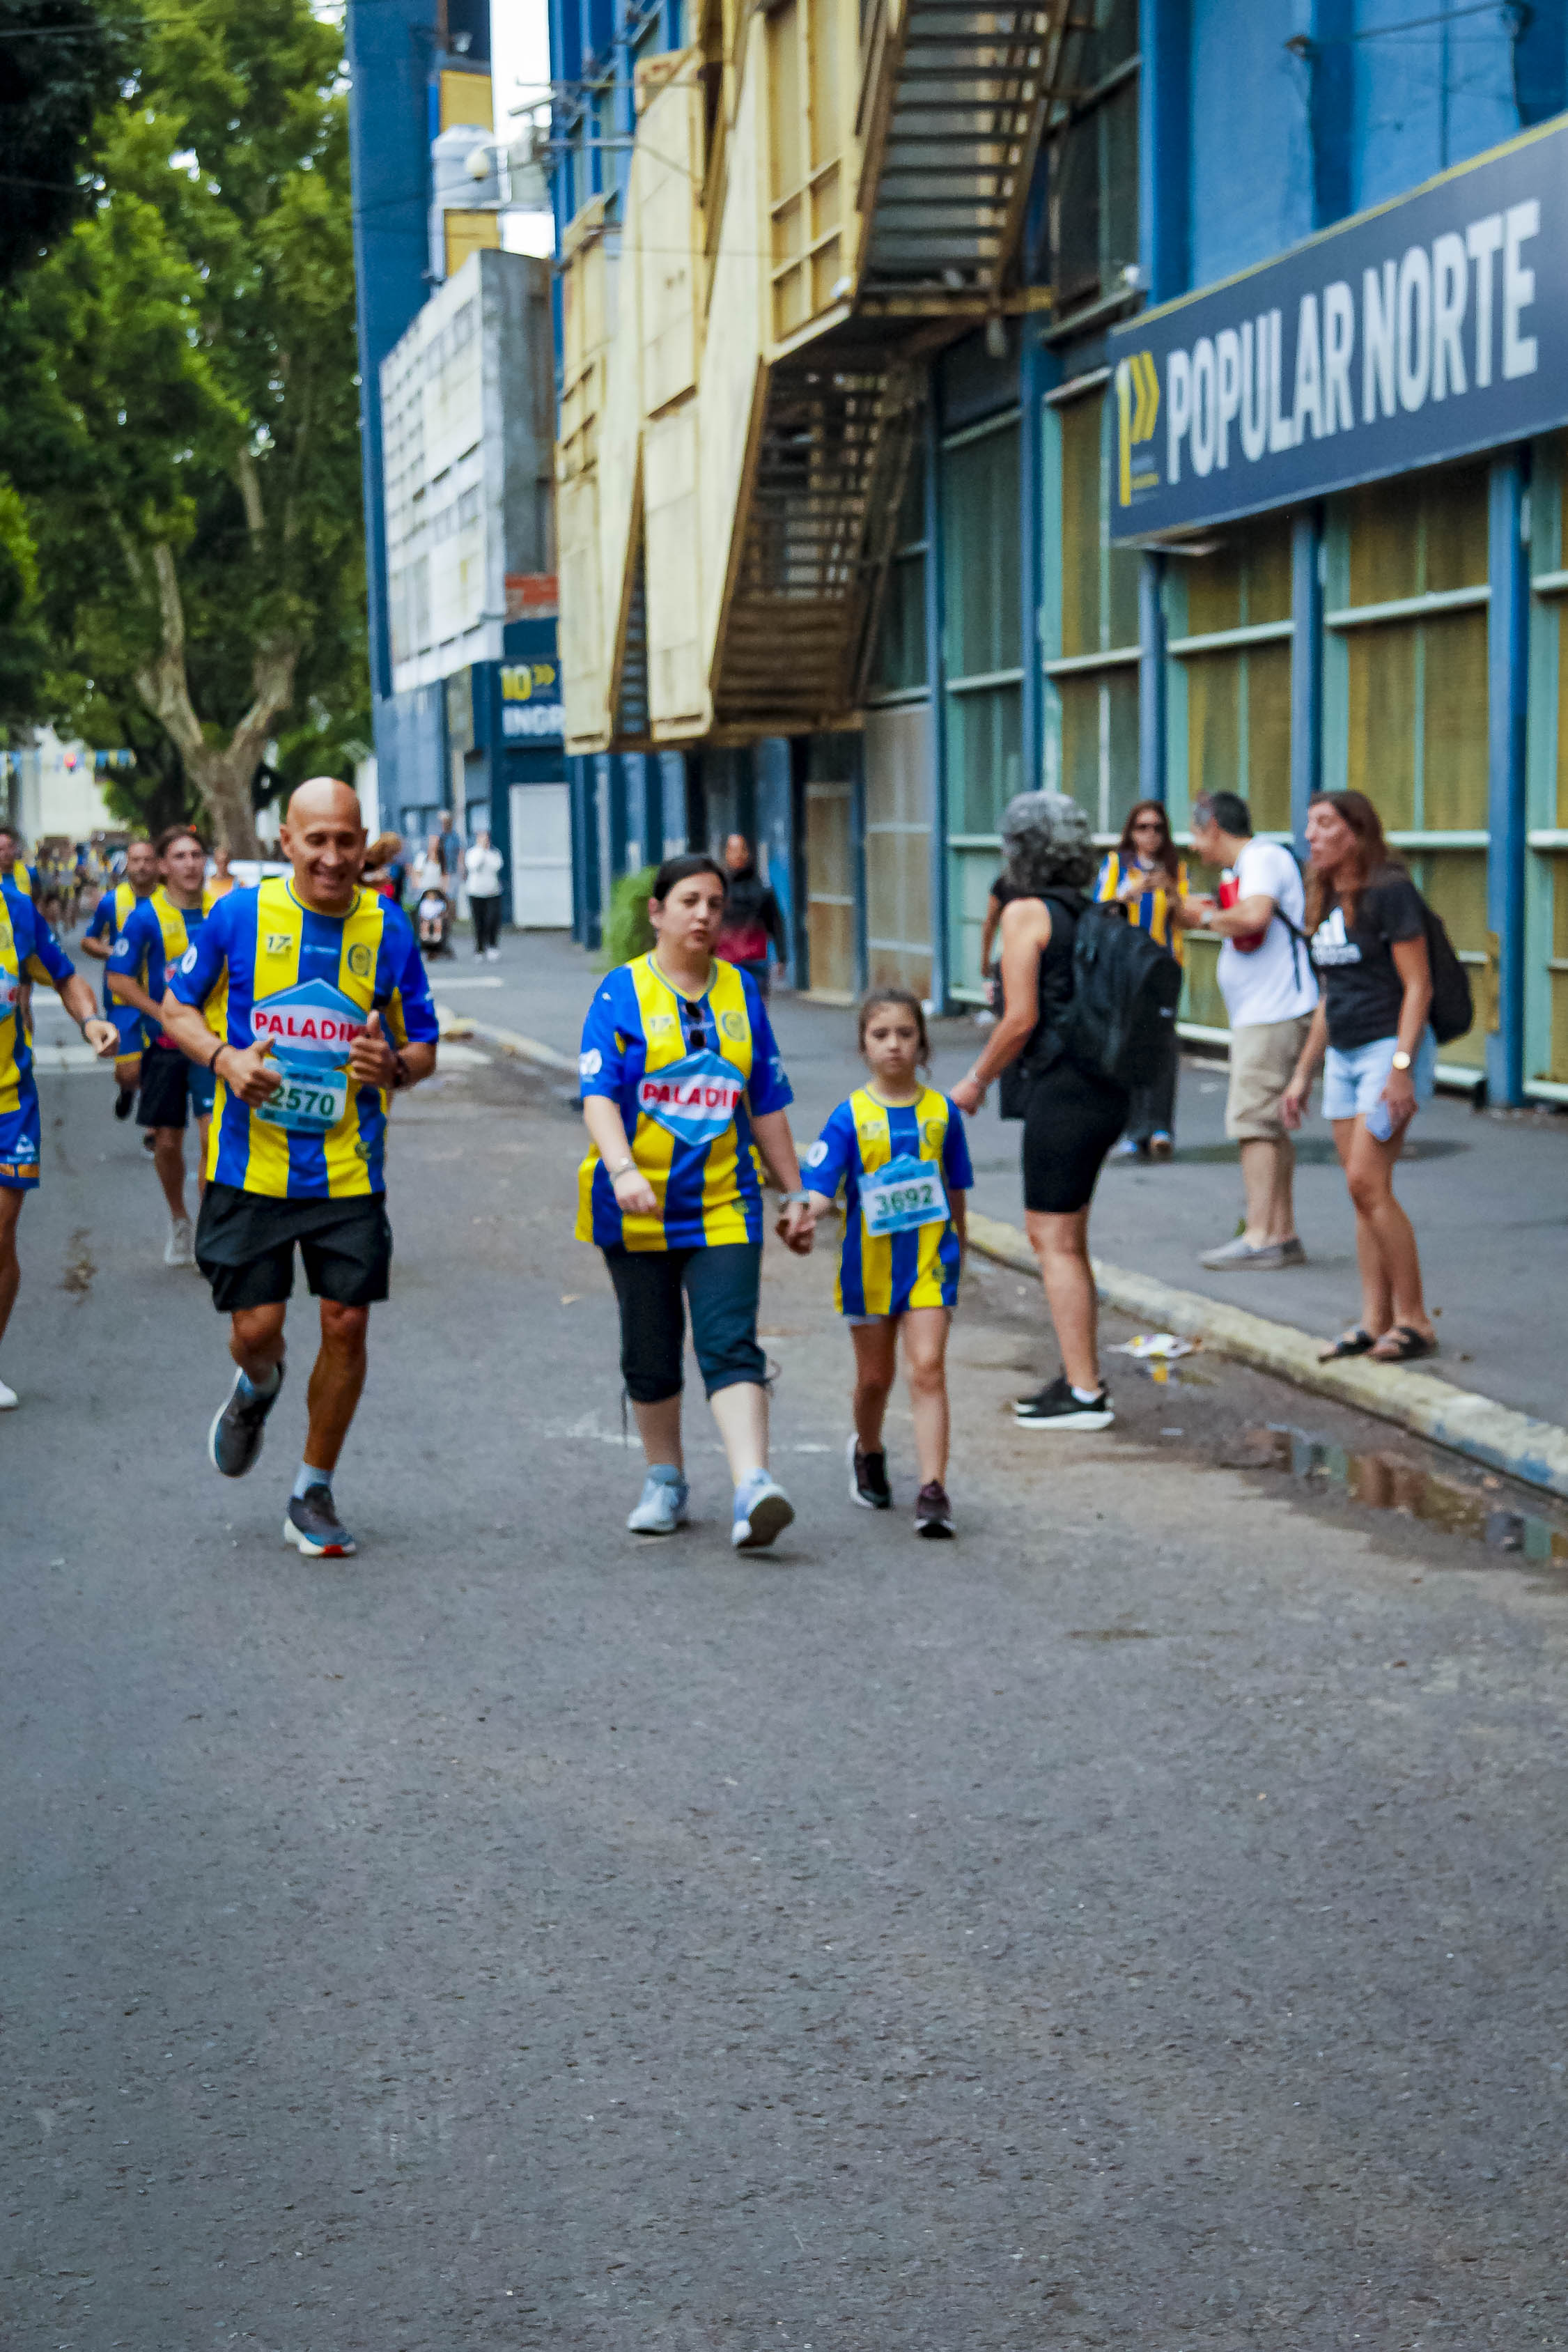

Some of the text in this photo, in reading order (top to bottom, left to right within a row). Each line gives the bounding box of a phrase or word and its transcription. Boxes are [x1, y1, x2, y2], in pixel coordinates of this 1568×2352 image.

[1167, 199, 1541, 485] POPULAR NORTE
[499, 664, 531, 701] 10
[269, 1085, 335, 1116] 2570
[874, 1184, 934, 1216] 3692
